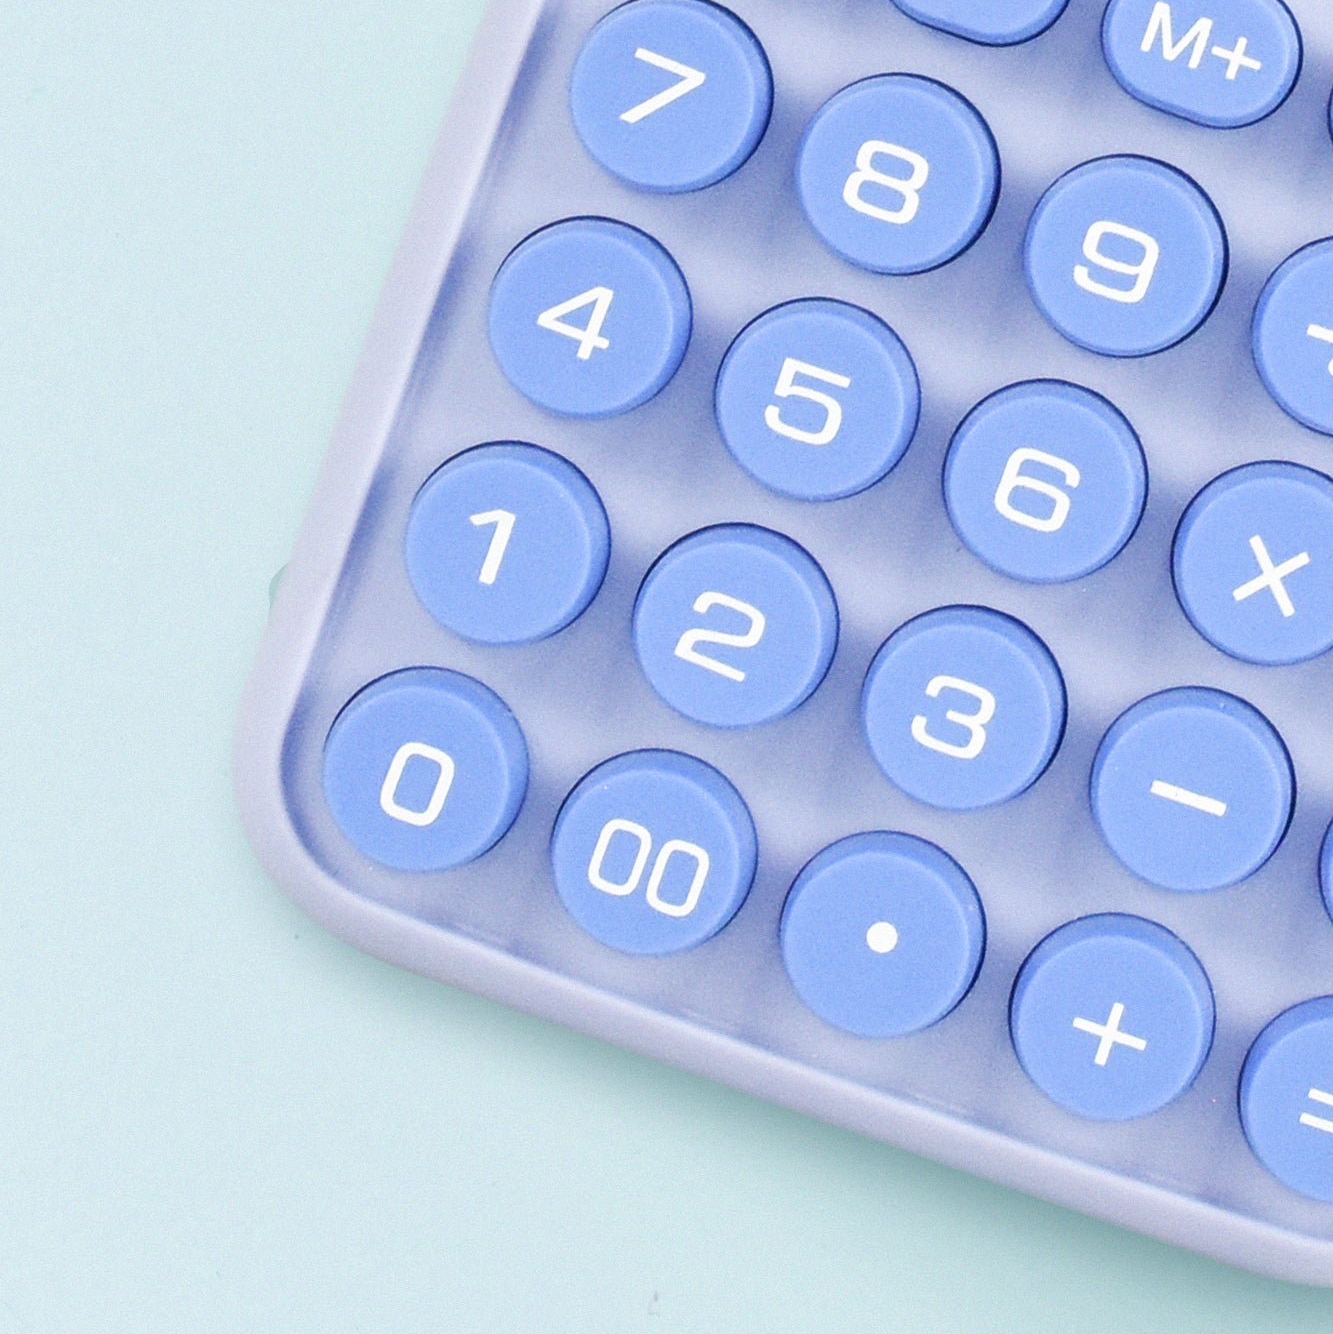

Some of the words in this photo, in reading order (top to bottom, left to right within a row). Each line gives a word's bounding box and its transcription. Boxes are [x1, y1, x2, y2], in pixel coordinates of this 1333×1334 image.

[1138, 0, 1265, 82] M+
[618, 46, 708, 126] 7
[841, 138, 932, 227] 8
[1071, 218, 1162, 306] 9
[535, 284, 616, 362] 4
[762, 355, 853, 448] 5
[992, 445, 1083, 535] 6
[467, 507, 518, 587] 1
[672, 589, 768, 684] 2
[909, 673, 998, 762] 3
[378, 740, 458, 829] 0
[586, 817, 712, 920] 00
